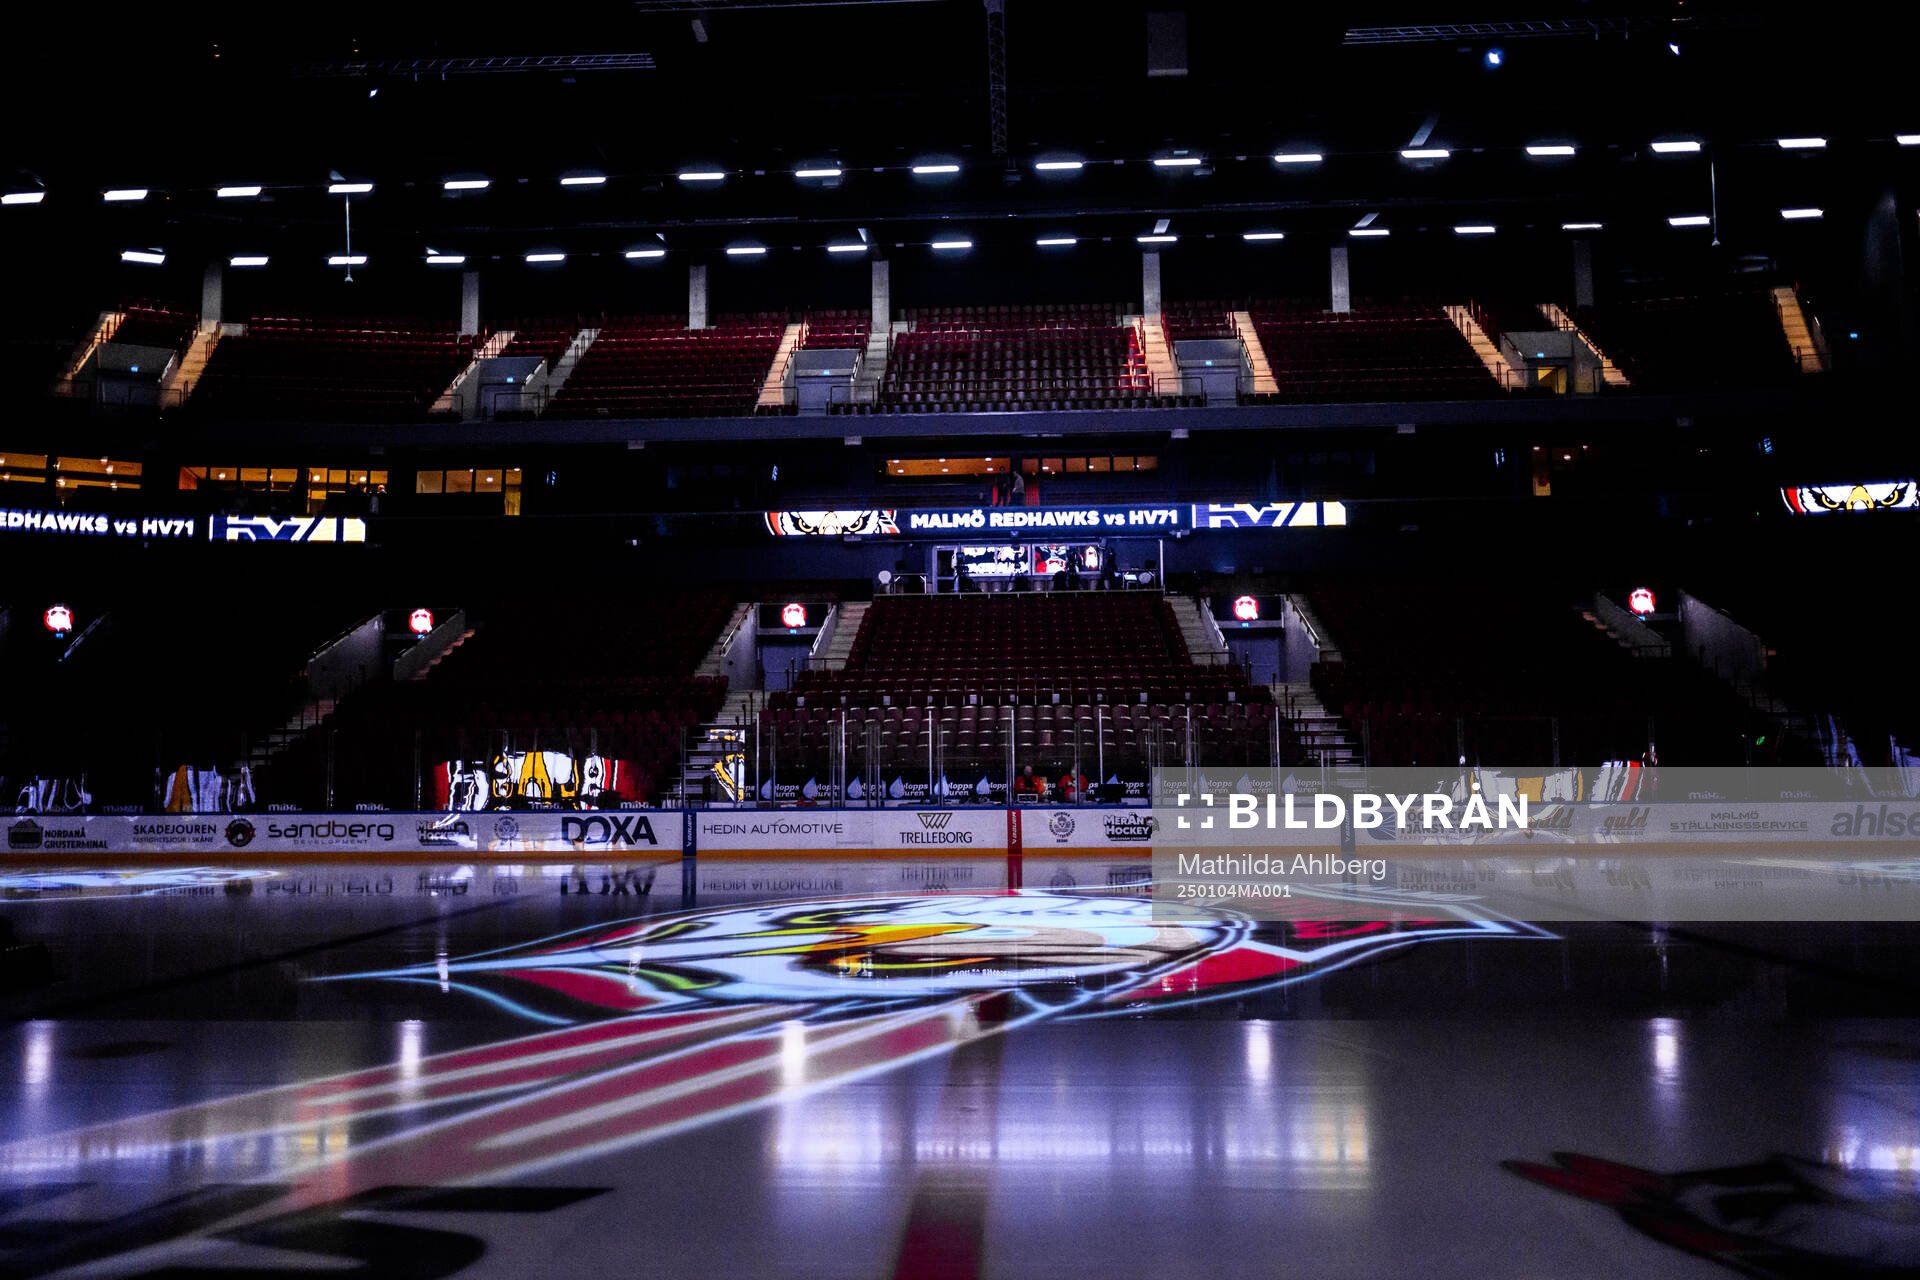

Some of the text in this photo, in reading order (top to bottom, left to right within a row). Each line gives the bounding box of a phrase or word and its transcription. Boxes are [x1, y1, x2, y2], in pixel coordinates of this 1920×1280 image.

[911, 509, 1178, 528] MALMÖ REDHAWKS vs HV71
[114, 520, 137, 534] vs
[143, 518, 194, 536] HV71
[1710, 811, 1759, 821] MALMÖ
[132, 824, 217, 835] SKADEJOUREN
[268, 821, 394, 840] sandberg
[562, 816, 658, 845] DOXA
[703, 823, 843, 834] HEDIN AUTOMOTIVE
[1105, 825, 1150, 835] HOCKEY
[1670, 820, 1808, 830] STÄLLNINGSSERVICE
[900, 831, 973, 843] TRELLEBORG
